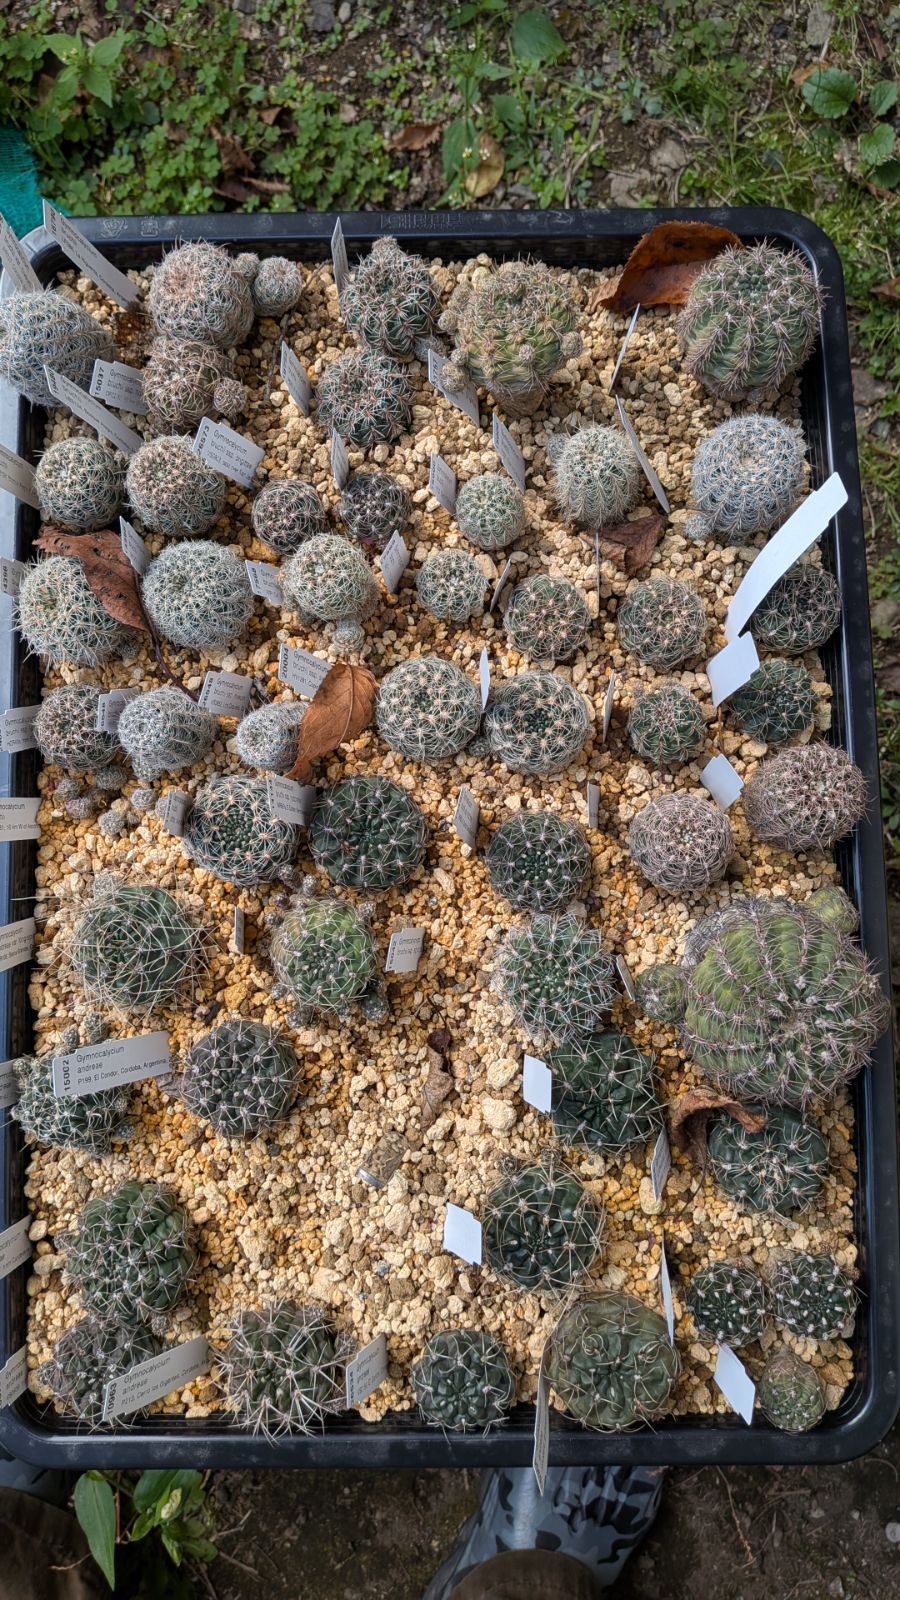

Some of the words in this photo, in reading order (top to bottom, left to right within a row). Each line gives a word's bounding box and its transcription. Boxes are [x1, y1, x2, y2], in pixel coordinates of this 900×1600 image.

[95, 367, 104, 395] 15037
[197, 425, 210, 456] 26573
[76, 1045, 125, 1063] Gymnocalycium
[76, 1062, 104, 1074] andreae
[62, 1059, 71, 1092] 15002
[123, 1356, 171, 1384] Gymnocalycium
[106, 1382, 117, 1416] 10963
